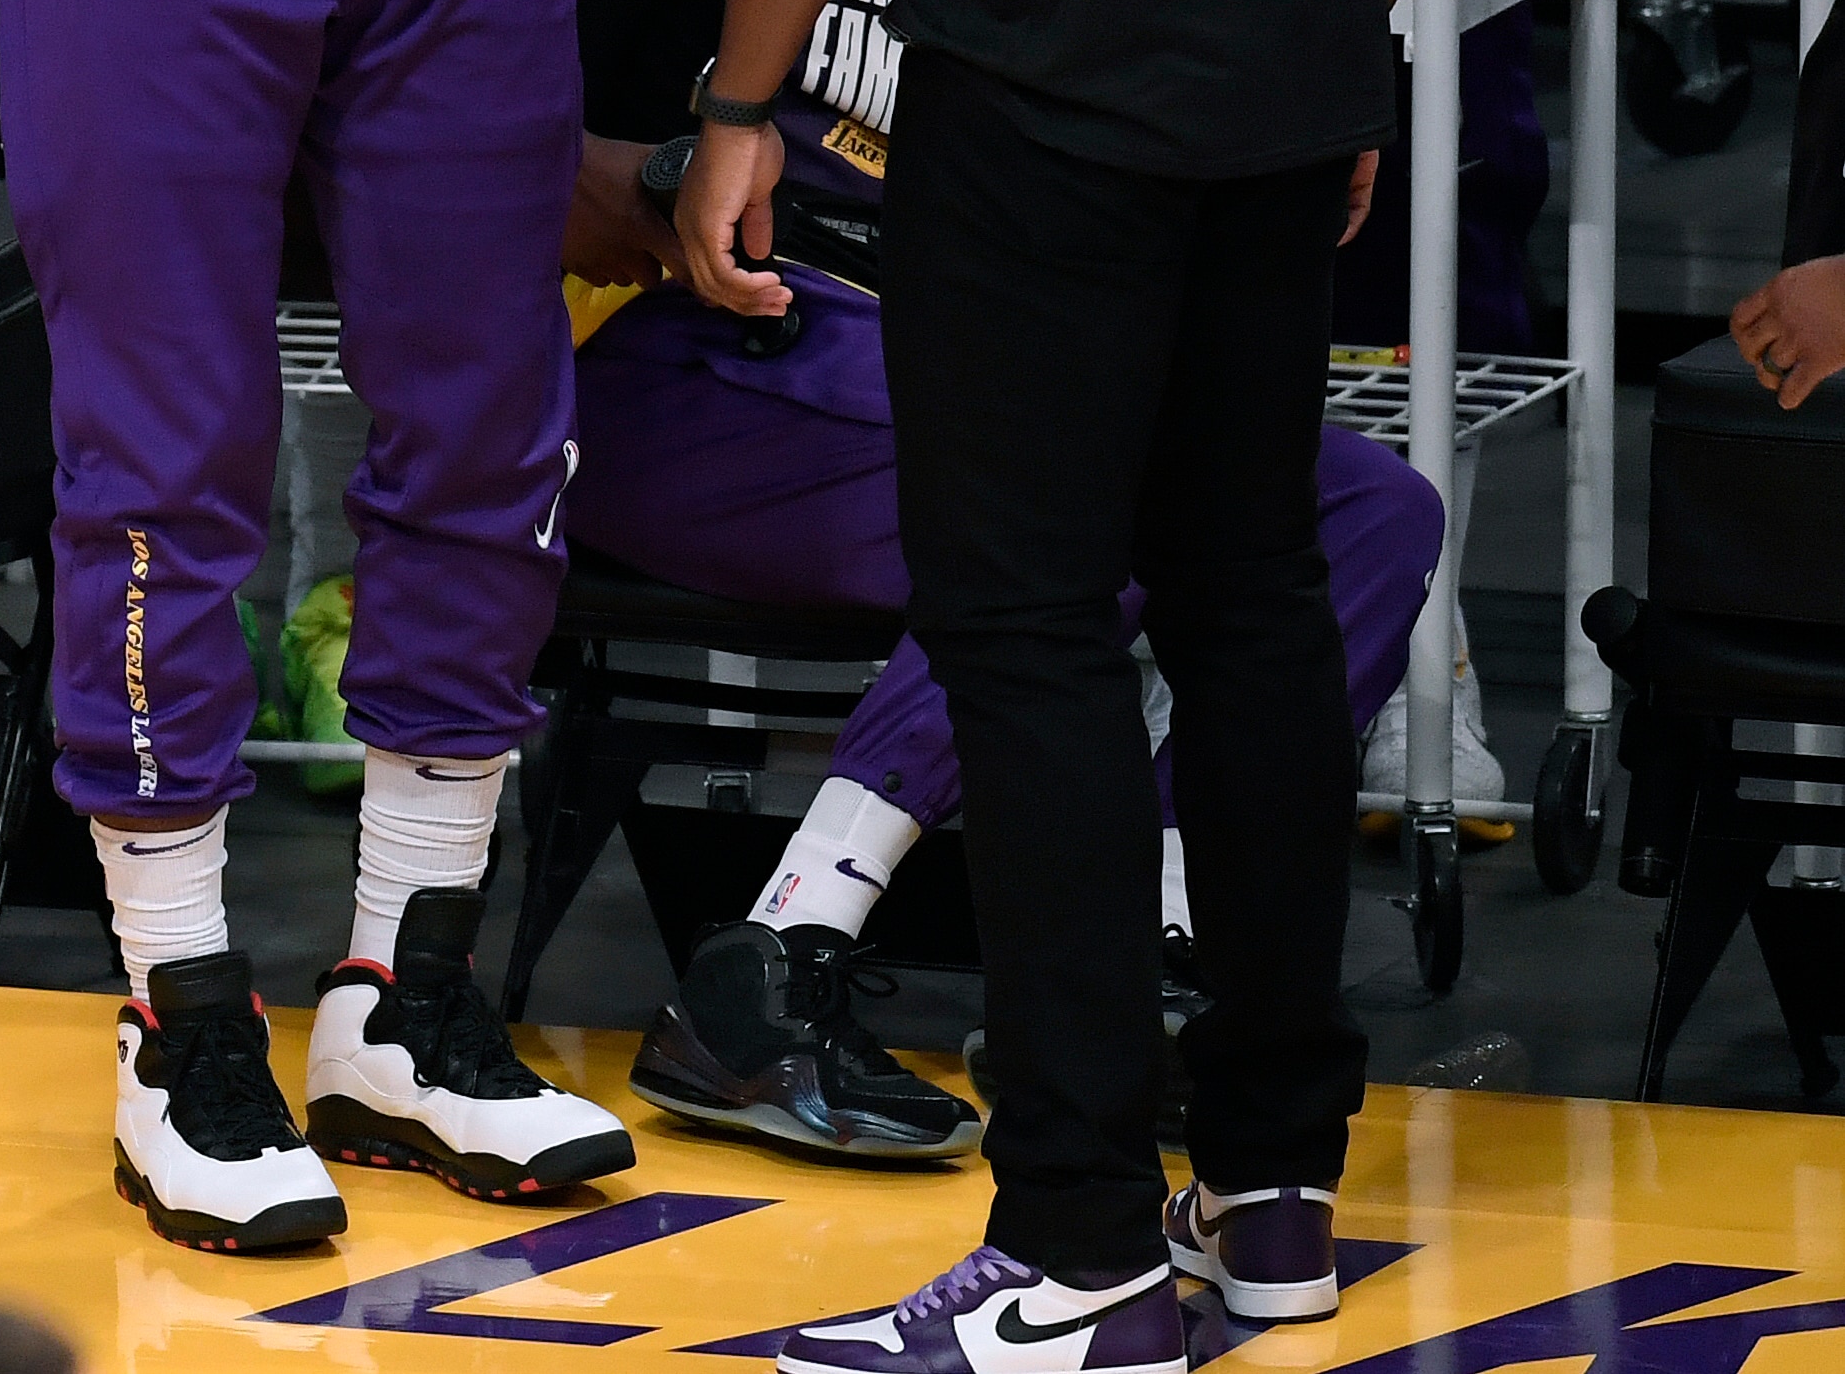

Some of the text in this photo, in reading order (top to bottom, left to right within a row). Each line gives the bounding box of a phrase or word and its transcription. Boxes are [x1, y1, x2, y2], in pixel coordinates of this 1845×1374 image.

[801, 2, 905, 135] FAM
[126, 527, 151, 580] LOS
[124, 580, 149, 715] ANGELES
